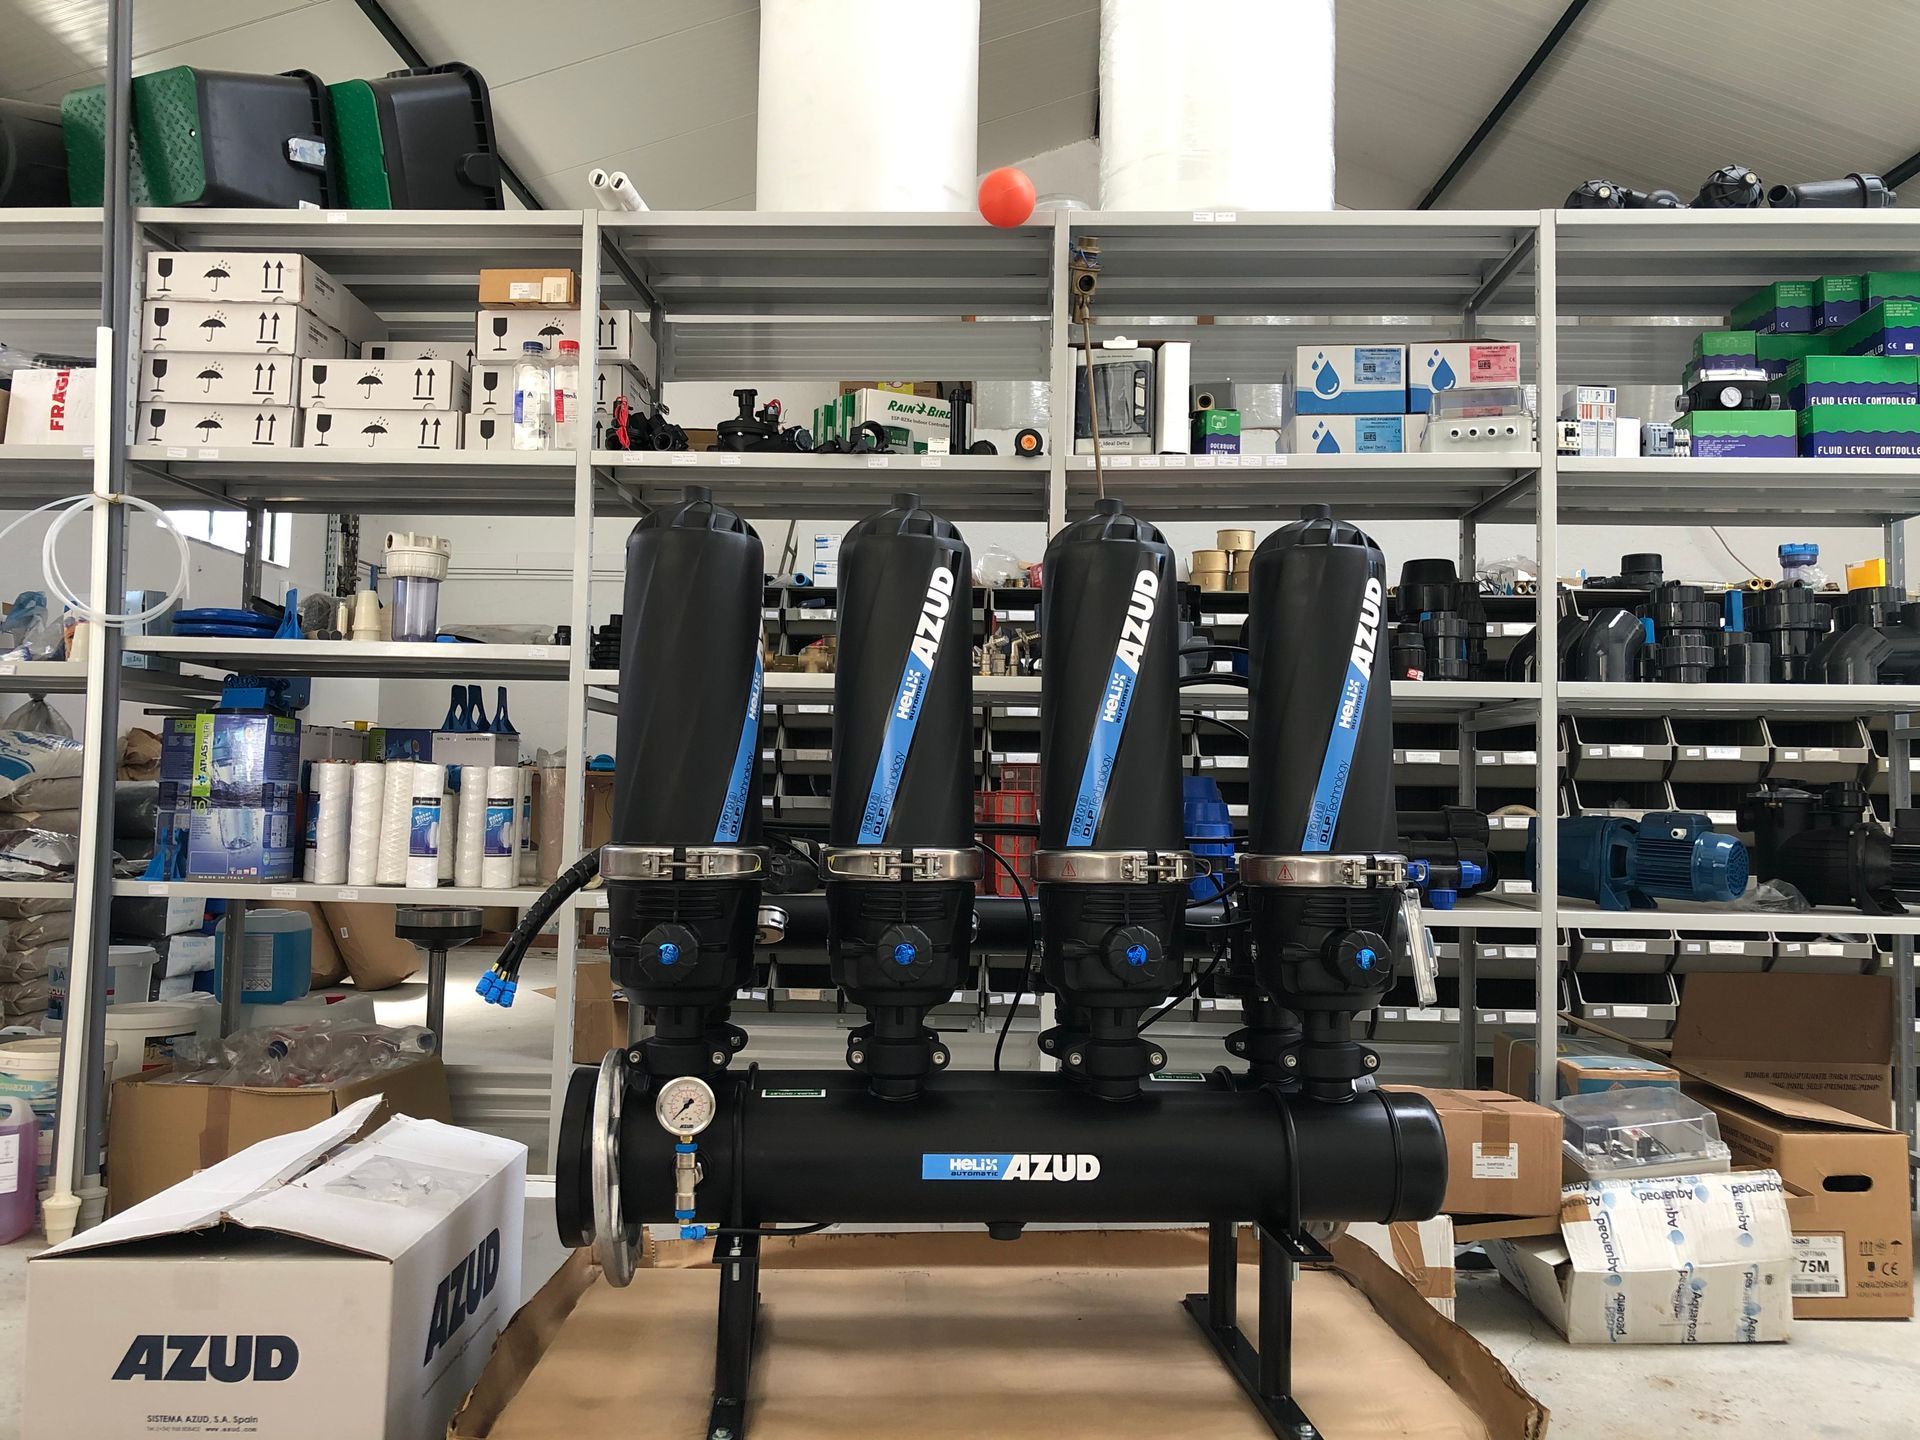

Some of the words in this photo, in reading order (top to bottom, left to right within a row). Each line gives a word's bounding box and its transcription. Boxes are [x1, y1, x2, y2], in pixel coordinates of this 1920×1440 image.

[887, 400, 916, 413] RAIN
[927, 406, 952, 420] BIRD
[1811, 396, 1835, 405] FLUID
[1837, 396, 1863, 405] LEVEL
[1818, 446, 1843, 455] FLUID
[1845, 446, 1871, 455] LEVEL
[910, 566, 954, 672] AZUD
[1116, 569, 1159, 675] AZUD
[1350, 577, 1382, 681] AZUD
[730, 807, 742, 835] DLP
[873, 808, 885, 835] DLP
[1082, 810, 1094, 837] DLP
[1320, 816, 1331, 843] DLP
[1001, 1154, 1101, 1182] AZUD
[1639, 1189, 1694, 1203] Aquaroad
[1732, 1181, 1784, 1196] Aquaroad
[1594, 1217, 1620, 1273] Aquaroad
[1800, 1260, 1830, 1273] 75M
[423, 1227, 501, 1368] AZUD
[111, 1335, 300, 1383] AZUD
[146, 1415, 182, 1423] SISTEMA
[232, 1415, 259, 1425] Spain
